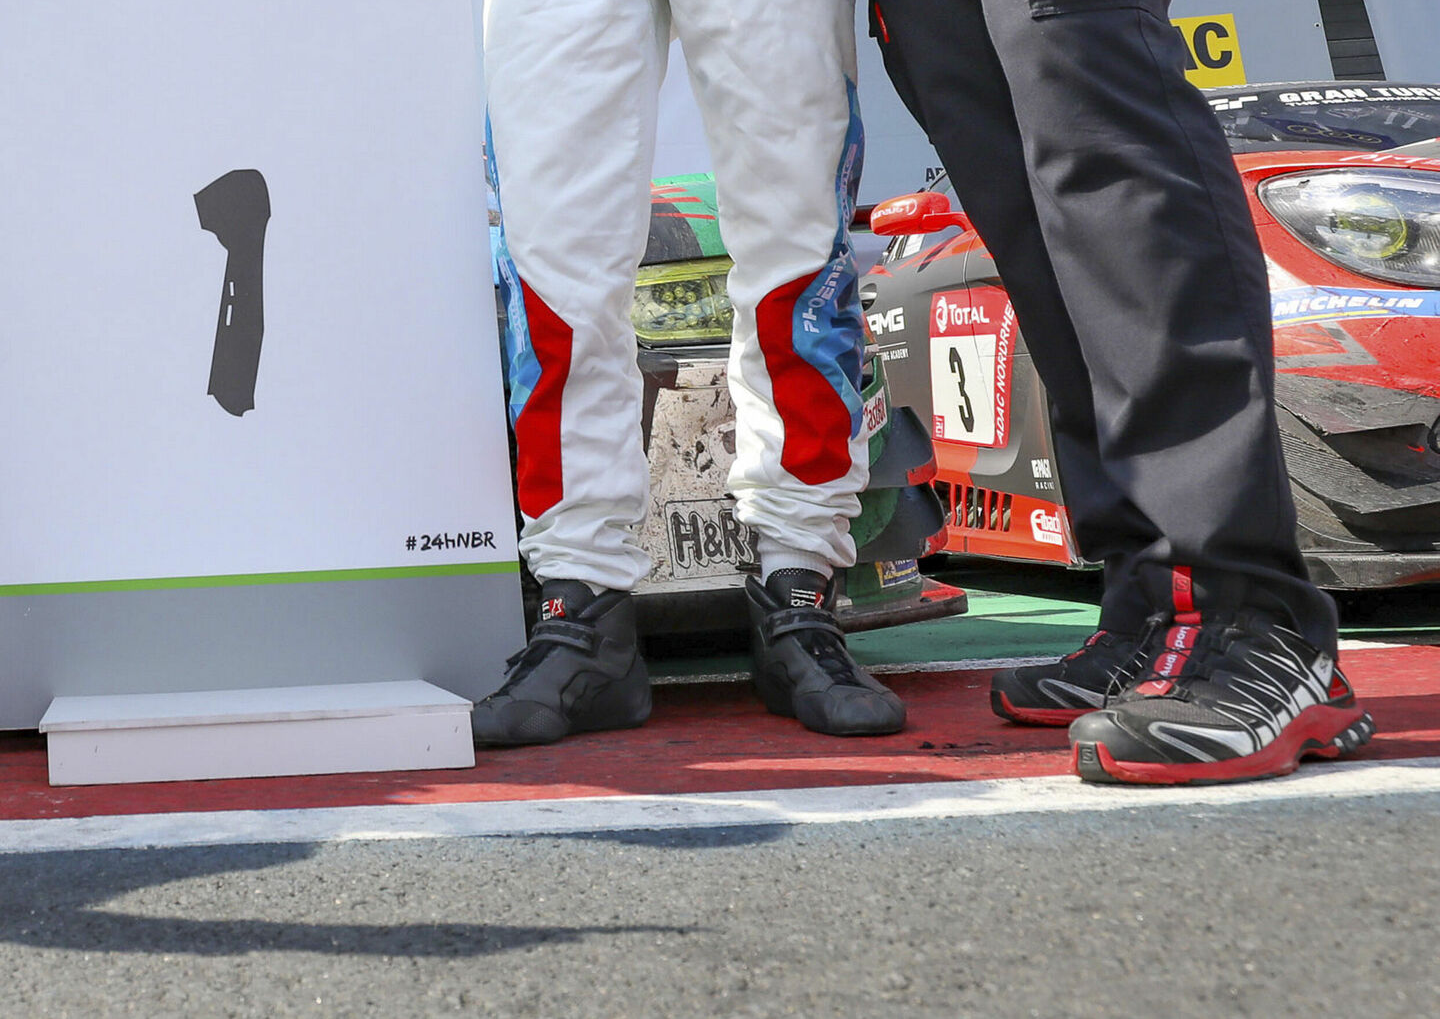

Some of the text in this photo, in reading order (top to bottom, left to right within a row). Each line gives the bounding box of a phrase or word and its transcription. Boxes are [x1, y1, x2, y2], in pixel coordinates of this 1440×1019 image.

[1279, 89, 1368, 103] GRAN
[193, 168, 271, 417] 1
[1272, 295, 1424, 317] MICHELIN
[948, 303, 990, 325] TOTAL
[949, 347, 975, 433] 3
[995, 395, 1006, 444] ADAC
[406, 531, 497, 552] #24hNBR
[672, 511, 745, 562] H&R
